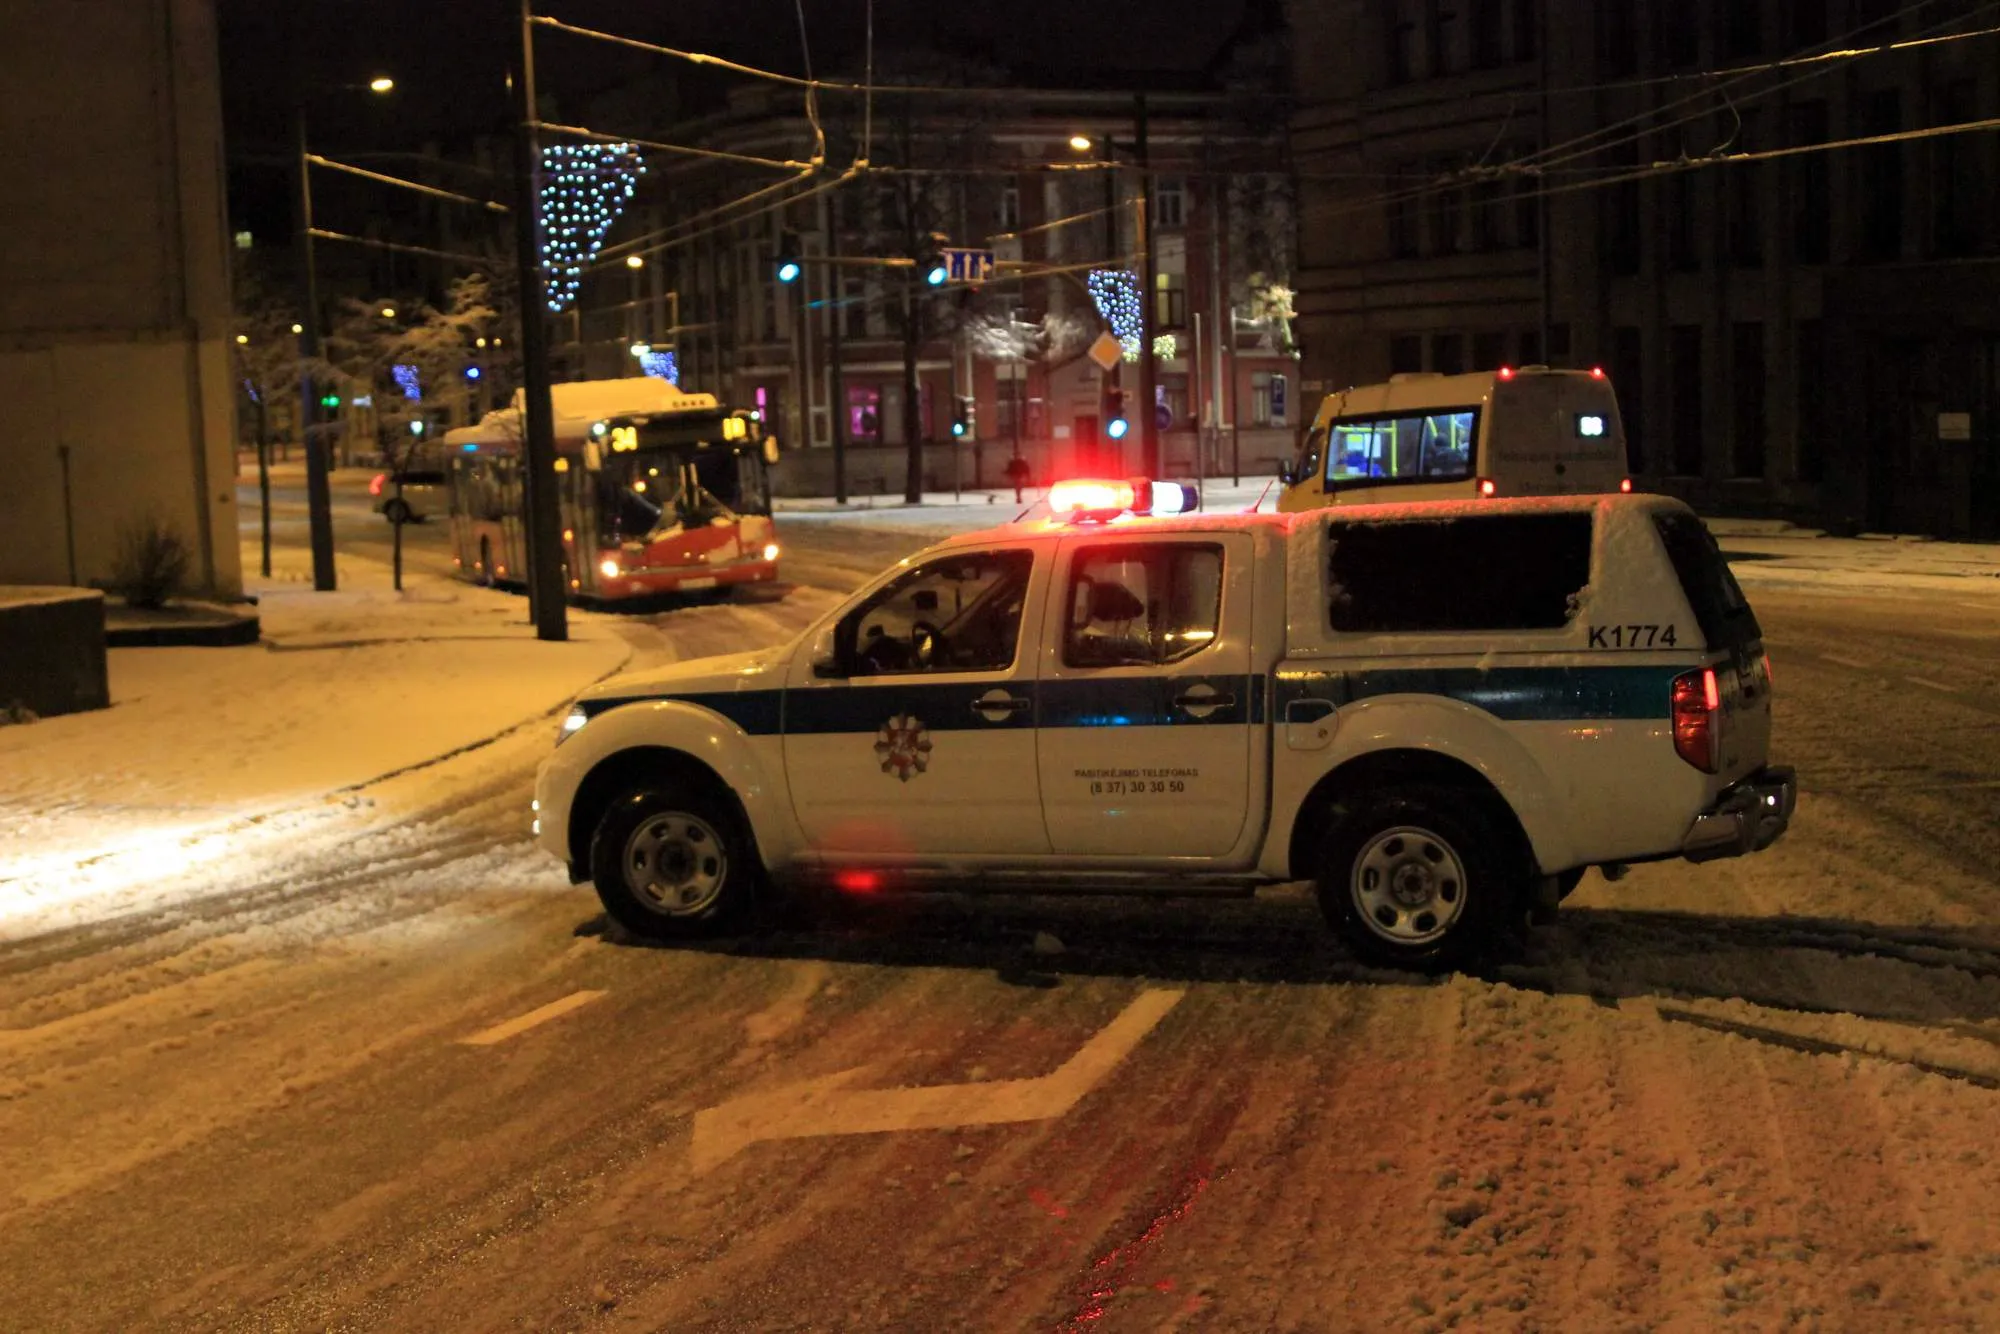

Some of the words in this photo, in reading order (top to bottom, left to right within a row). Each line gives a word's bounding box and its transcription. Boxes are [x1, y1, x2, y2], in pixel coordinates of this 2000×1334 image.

[1588, 623, 1677, 648] K1774
[1142, 767, 1199, 777] TELEFONAS
[1106, 780, 1126, 795] 37)
[1130, 781, 1145, 793] 30
[1150, 780, 1165, 793] 30
[1169, 780, 1185, 793] 50
